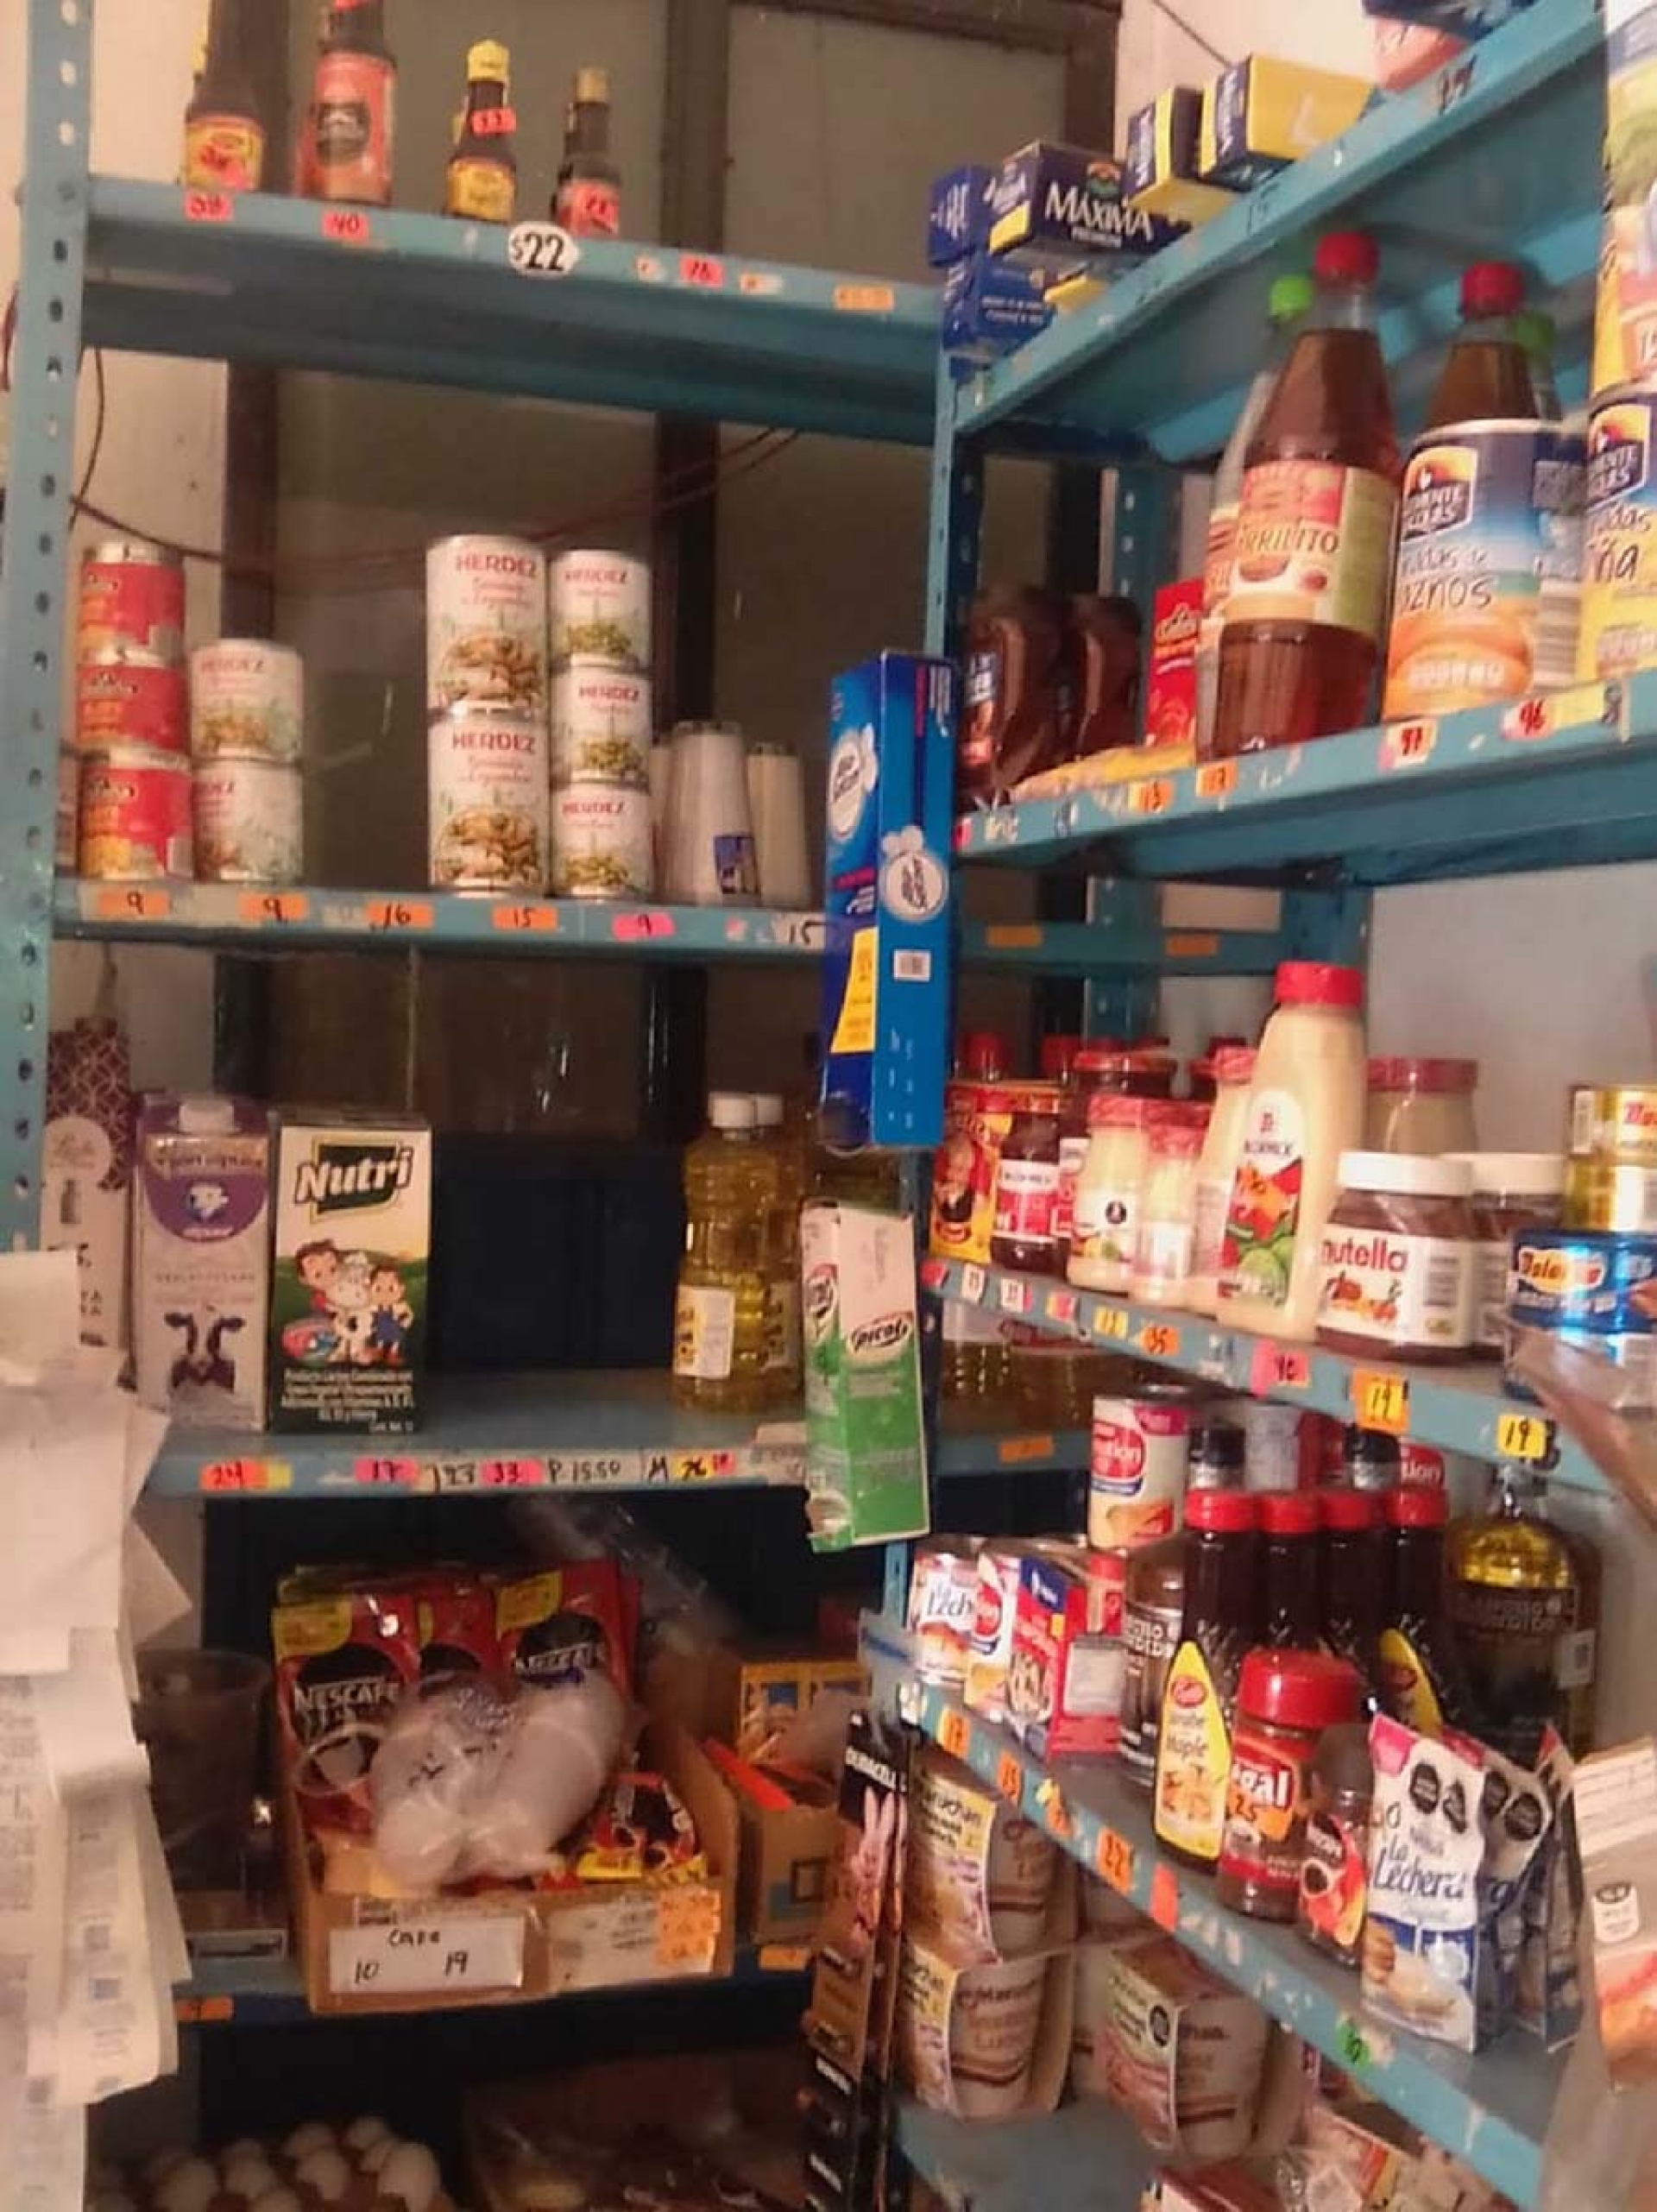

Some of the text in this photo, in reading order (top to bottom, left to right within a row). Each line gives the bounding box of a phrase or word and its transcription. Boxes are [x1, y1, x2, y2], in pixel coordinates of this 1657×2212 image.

[511, 232, 565, 274] $22
[452, 732, 536, 754] HERDEZ
[513, 906, 533, 930] 15
[294, 1146, 415, 1205] Nutri
[1320, 1237, 1408, 1273] nutella
